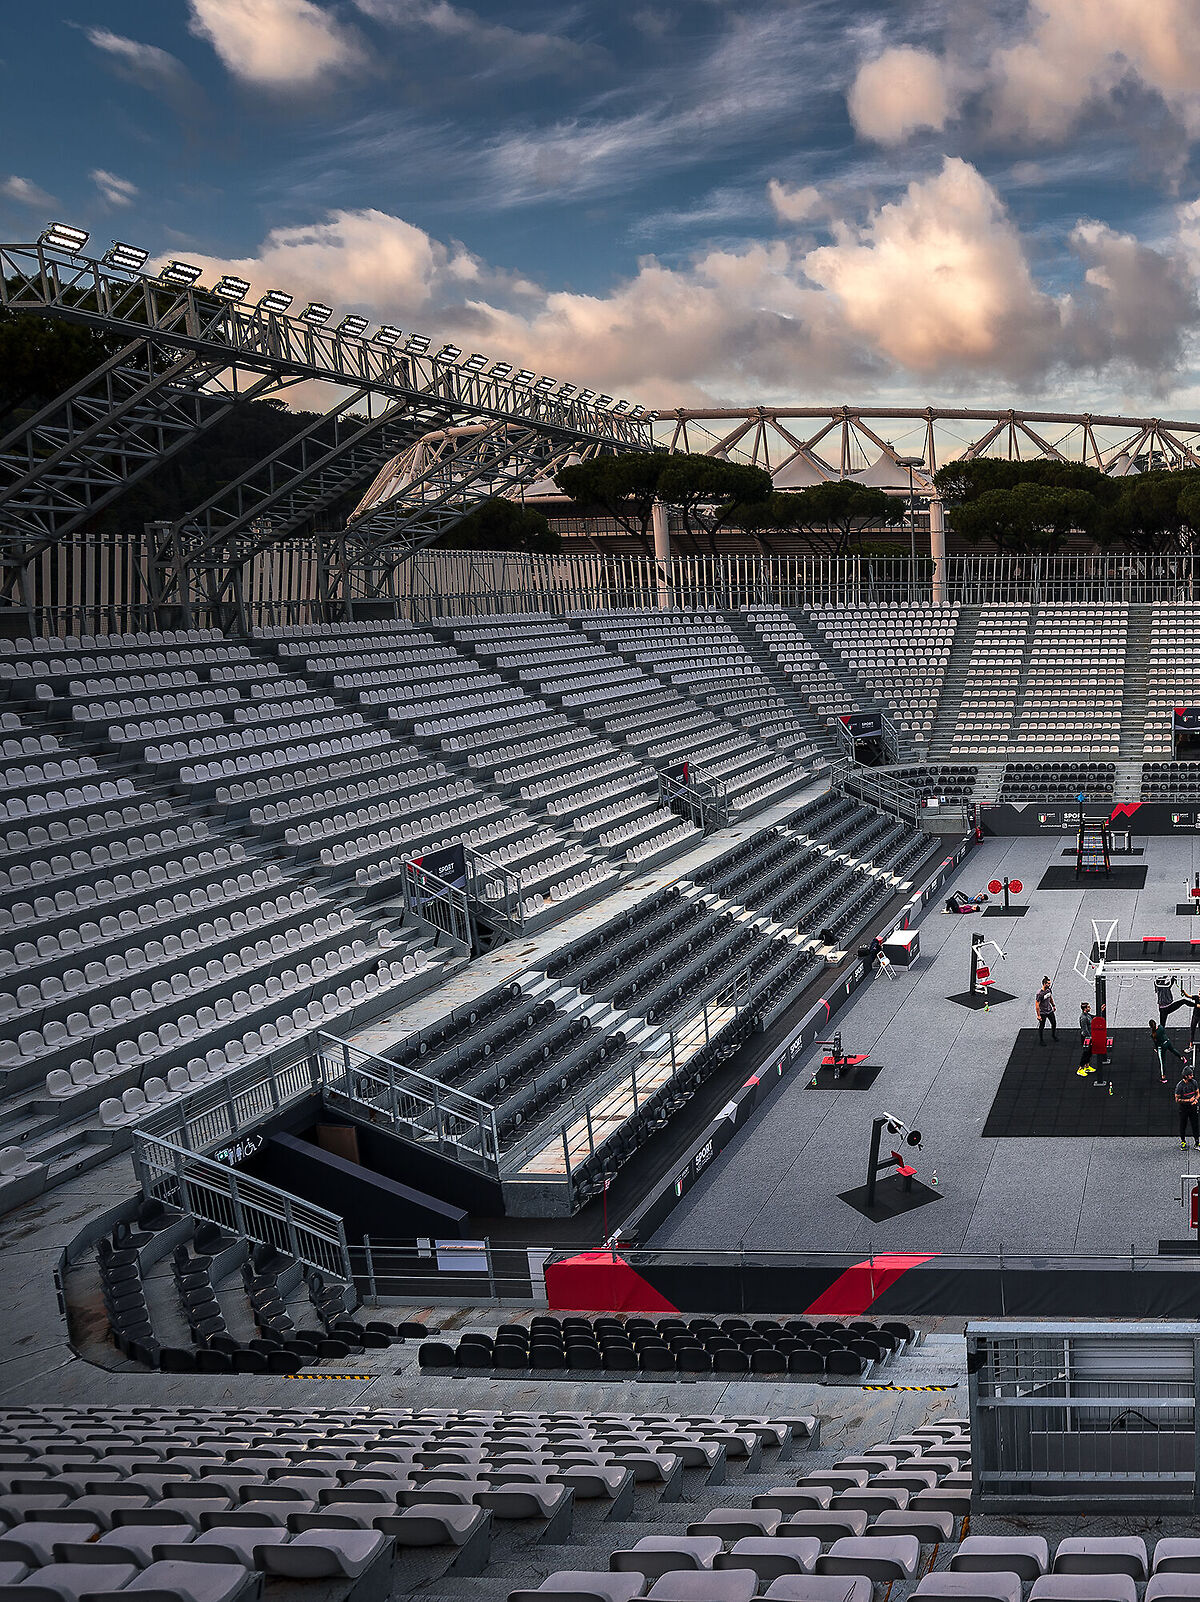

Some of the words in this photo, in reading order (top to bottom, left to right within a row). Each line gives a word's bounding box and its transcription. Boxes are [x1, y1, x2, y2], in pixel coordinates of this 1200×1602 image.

[438, 862, 455, 873] SPORT
[790, 1035, 803, 1054] SPORT
[695, 1138, 714, 1167] SPORT
